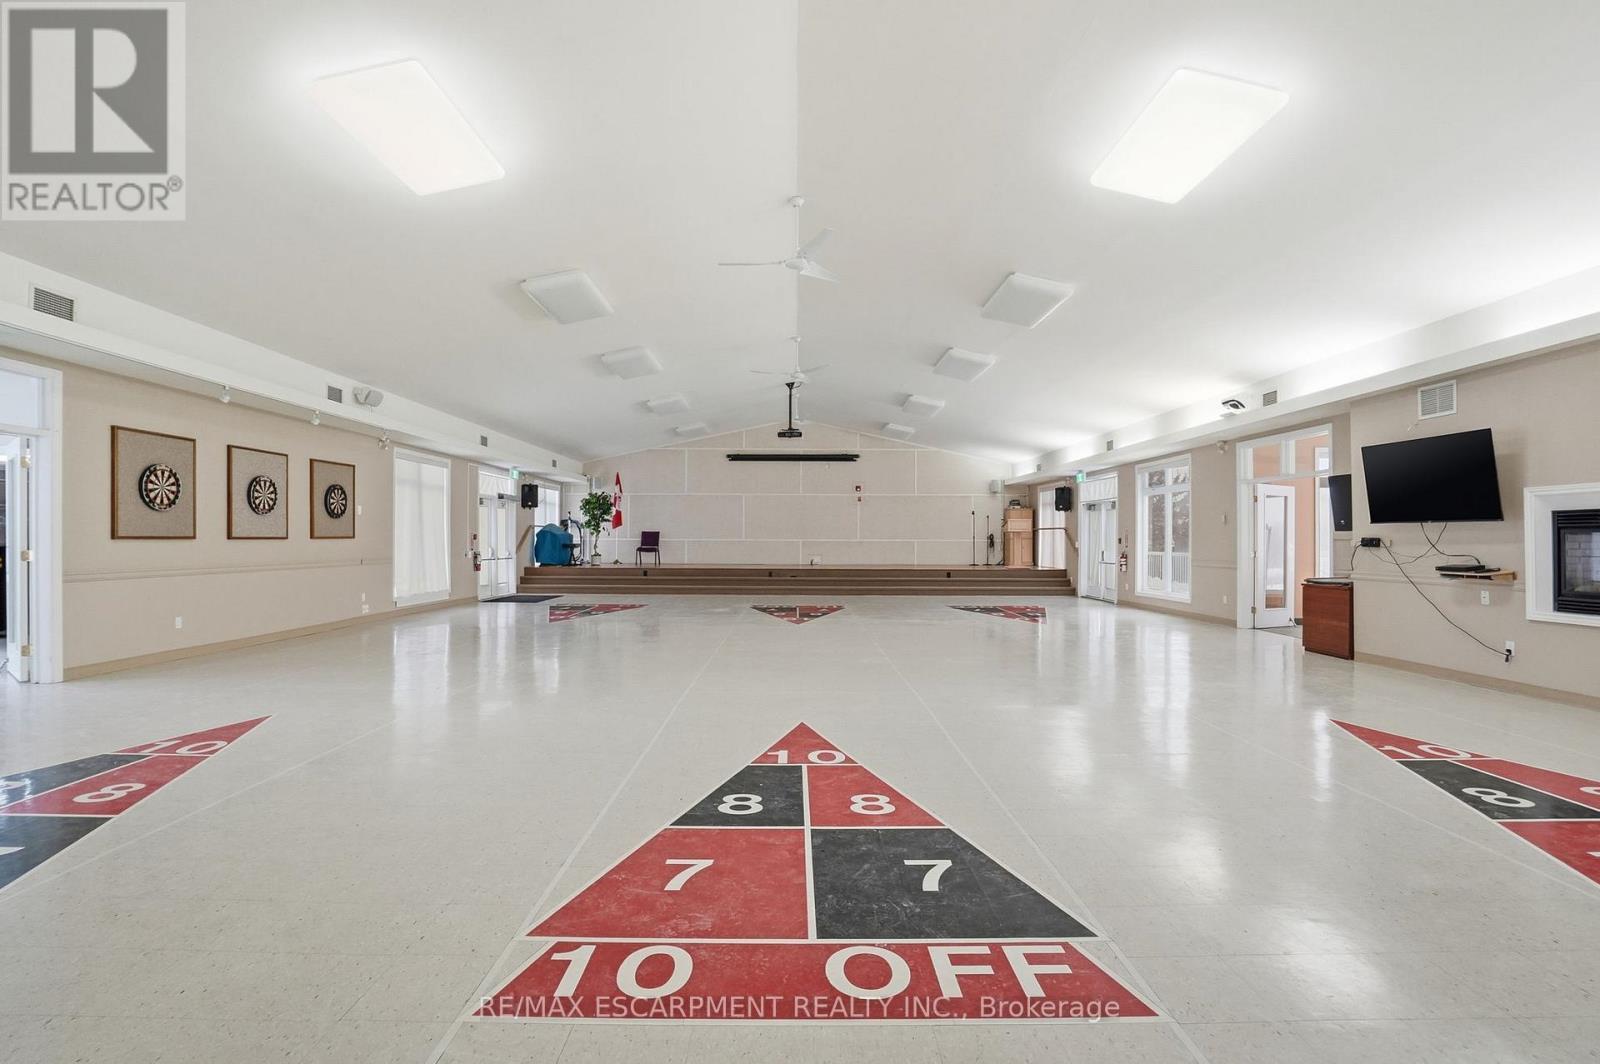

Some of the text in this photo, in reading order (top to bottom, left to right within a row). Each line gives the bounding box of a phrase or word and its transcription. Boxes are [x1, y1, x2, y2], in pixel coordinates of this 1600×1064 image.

[140, 740, 228, 755] 10
[767, 750, 846, 764] 10
[1379, 744, 1472, 759] 10
[72, 783, 146, 803] 8
[1461, 787, 1536, 808] 8
[717, 793, 763, 815] 8
[850, 794, 896, 815] 8
[664, 859, 714, 891] 7
[903, 859, 952, 892] 7
[551, 945, 1073, 999] 10 OFF
